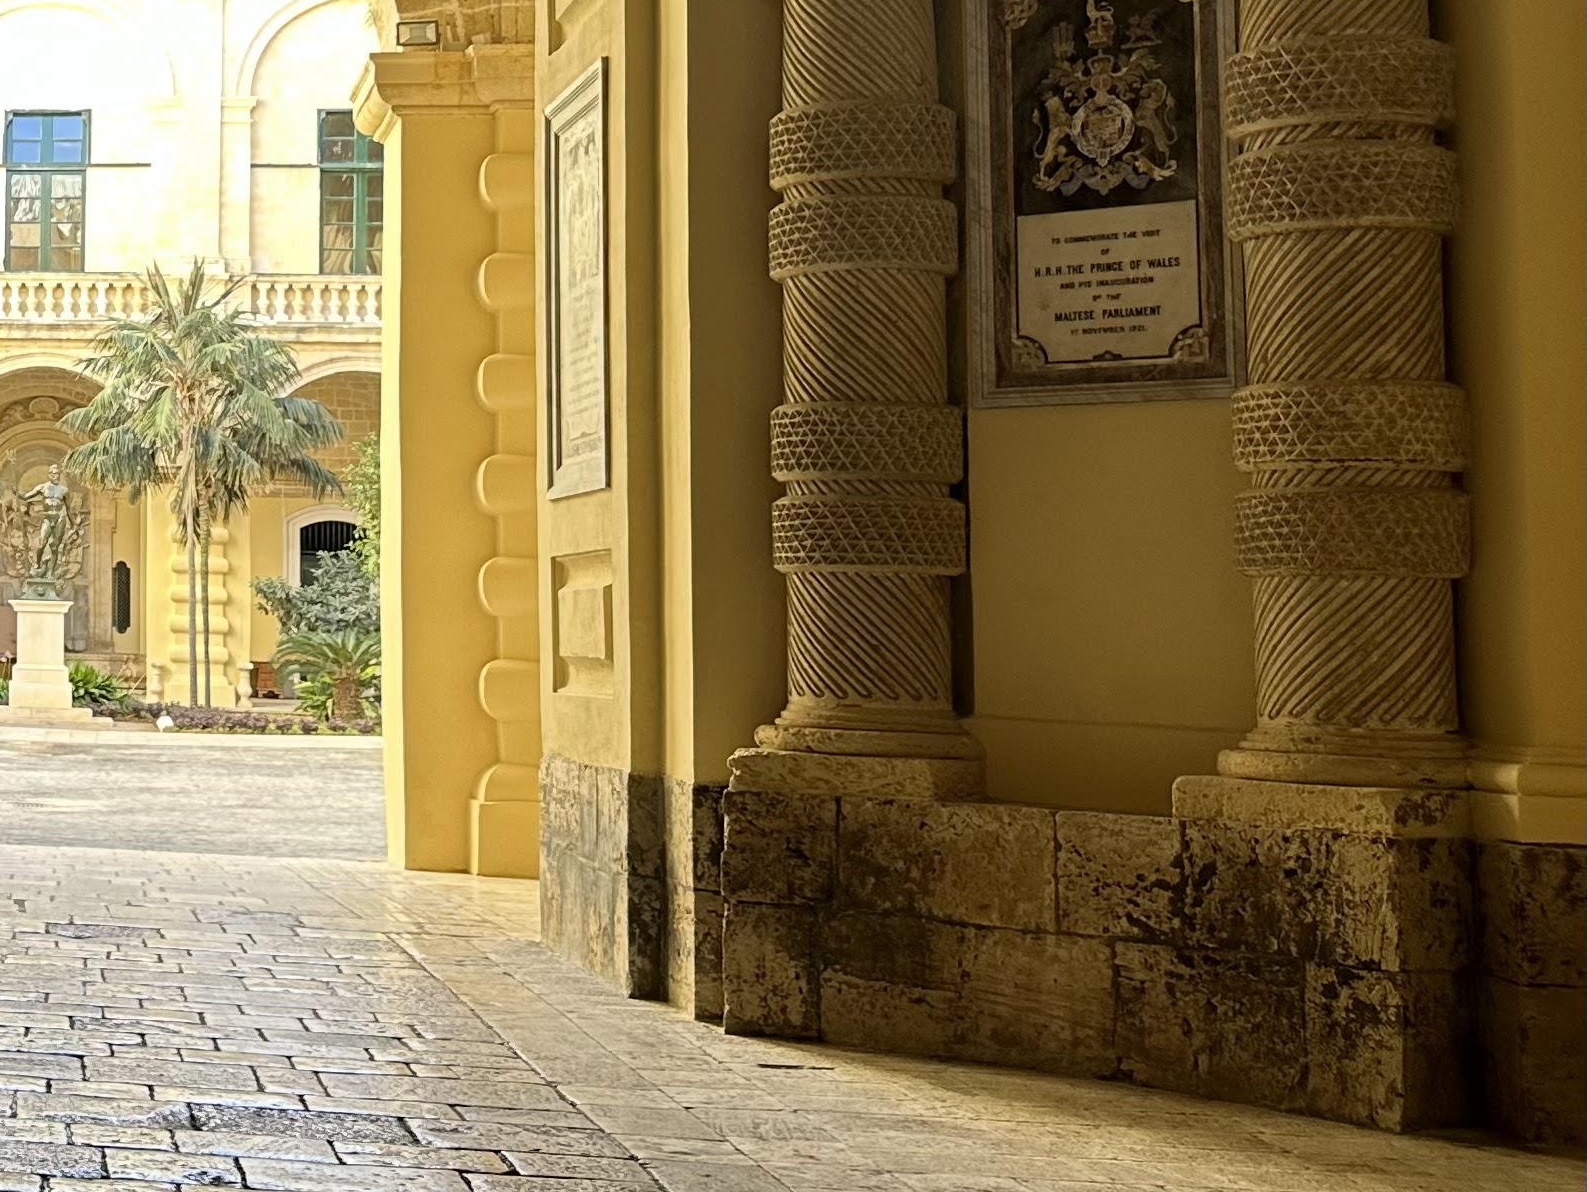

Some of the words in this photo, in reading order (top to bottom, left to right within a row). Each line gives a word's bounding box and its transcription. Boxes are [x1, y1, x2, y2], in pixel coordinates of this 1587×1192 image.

[1091, 260, 1123, 273] PRINCE
[1130, 259, 1142, 270] OF
[1148, 257, 1181, 268] WALES
[1054, 310, 1095, 322] MALTESE
[1102, 305, 1162, 320] PARLIAMENT
